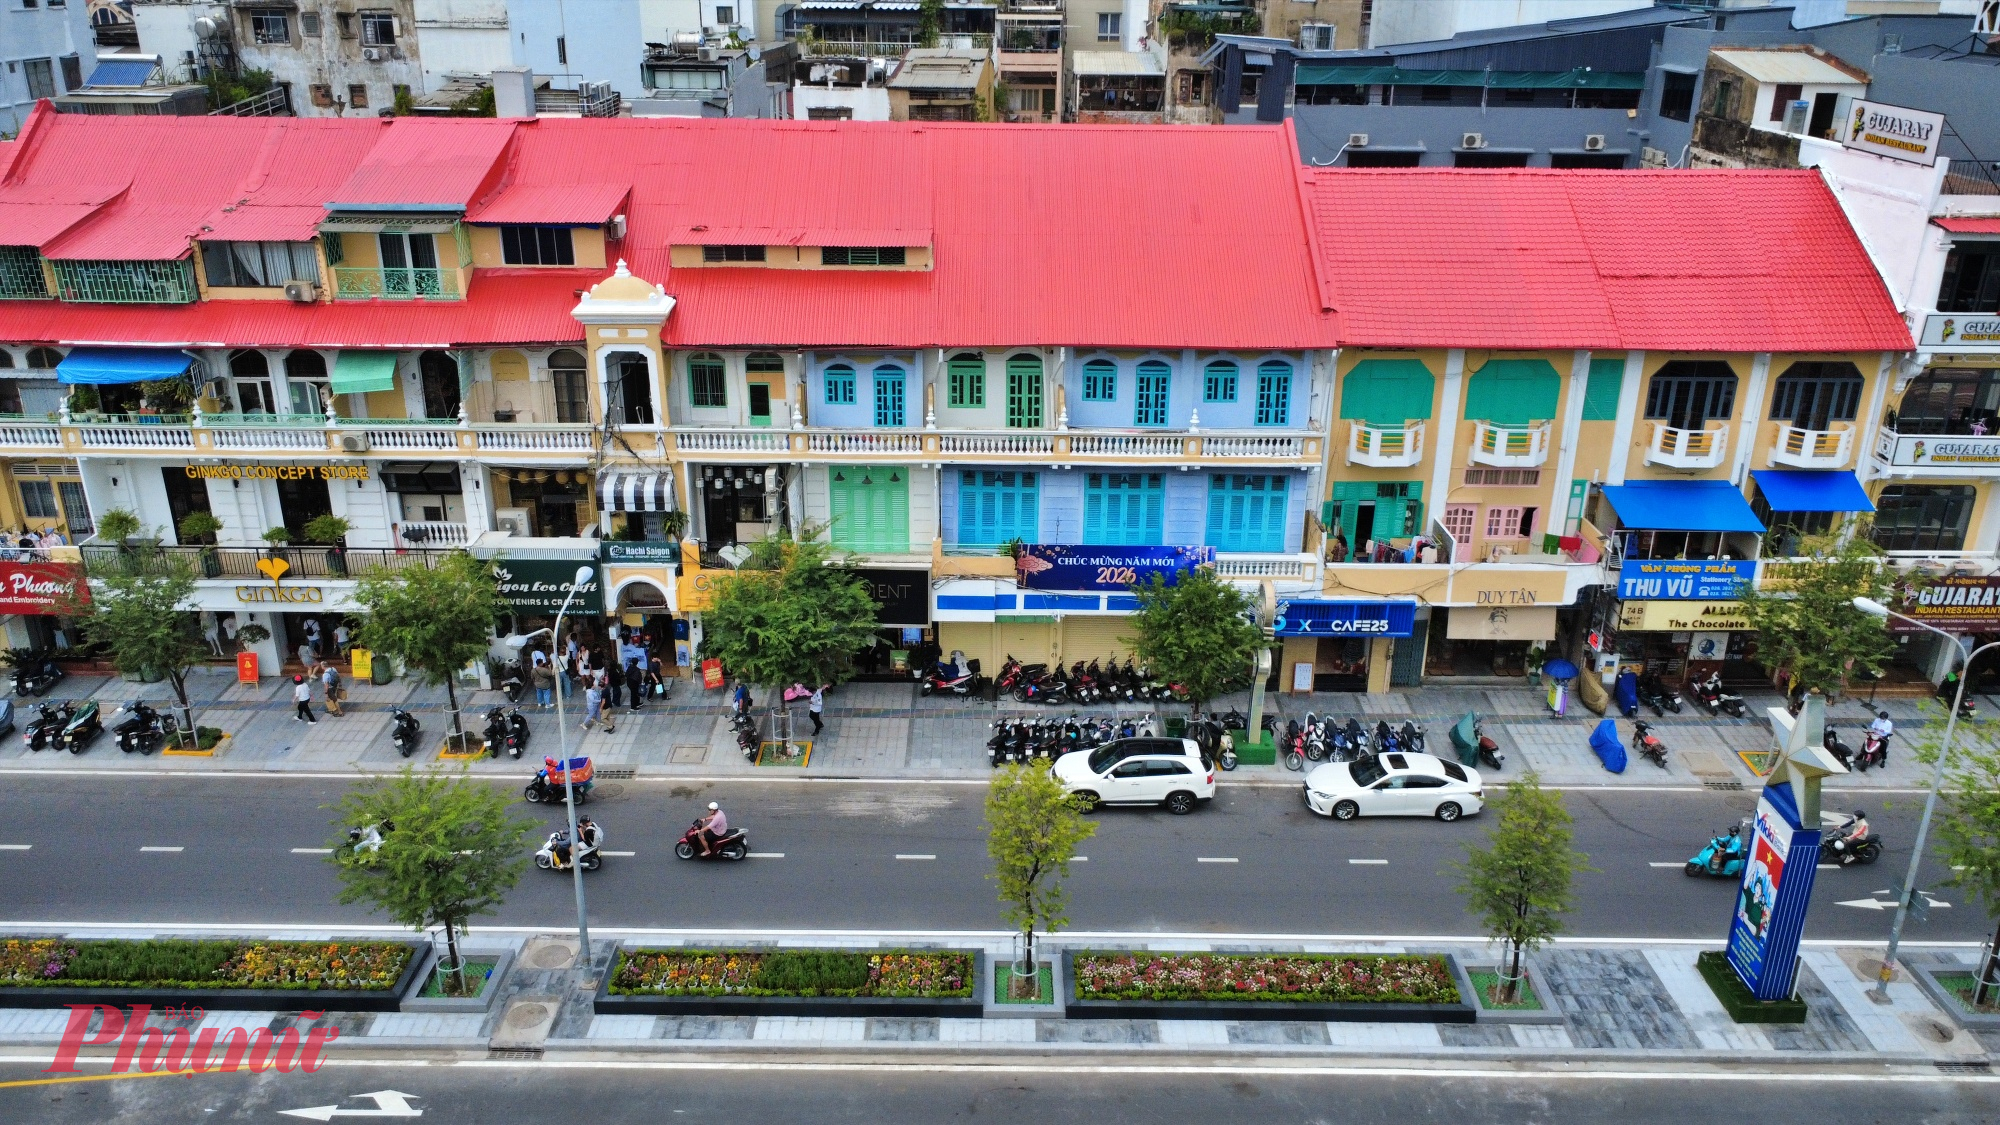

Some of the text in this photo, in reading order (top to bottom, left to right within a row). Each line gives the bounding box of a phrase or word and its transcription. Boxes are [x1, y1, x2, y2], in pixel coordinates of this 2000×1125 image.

[1867, 113, 1933, 140] GUJARAT
[1864, 133, 1928, 154] INDIAN RESTAURANT
[185, 465, 370, 480] GINKGO CONCEPT STORE
[625, 546, 670, 556] Hachi Saigon
[1058, 555, 1175, 567] CHÚC MỪNG NĂM MỚI
[1640, 563, 1662, 573] VĂN
[1665, 562, 1701, 573] PHÒNG
[1096, 567, 1137, 584] 2026
[1700, 576, 1731, 584] Stationery
[531, 581, 557, 592] Eco
[1624, 574, 1694, 597] THU VŨ
[13, 596, 55, 604] Embroidery
[1477, 588, 1537, 603] DUY TÂN
[1915, 606, 1945, 614] INDIAN
[1299, 619, 1312, 631] X
[1331, 620, 1389, 631] CAFE25
[1669, 619, 1688, 628] The
[1691, 619, 1746, 628] Chocolate
